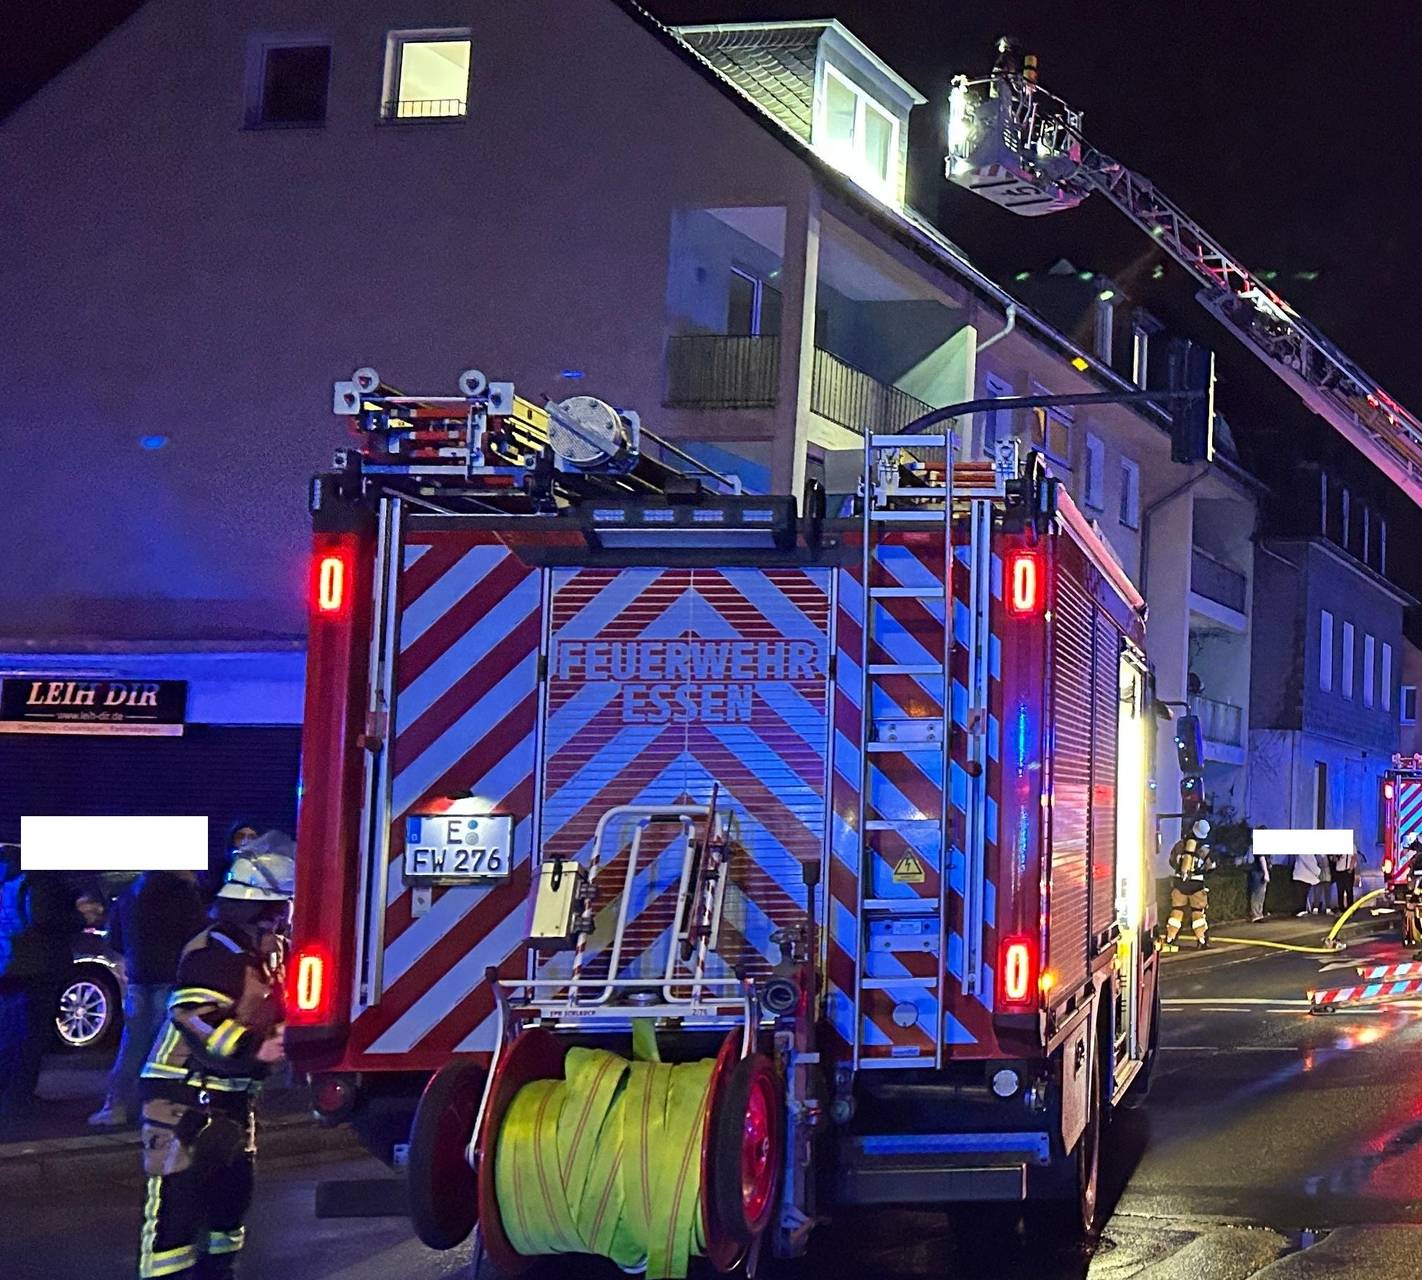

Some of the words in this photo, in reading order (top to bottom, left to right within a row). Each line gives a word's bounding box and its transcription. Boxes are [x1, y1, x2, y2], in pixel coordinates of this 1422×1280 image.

[558, 641, 818, 680] FEUERWEHR
[26, 682, 102, 706] LEIH
[104, 683, 160, 706] DIR
[622, 684, 753, 723] ESSEN
[447, 820, 463, 844] E
[413, 849, 447, 872] FW
[454, 848, 501, 872] 276
